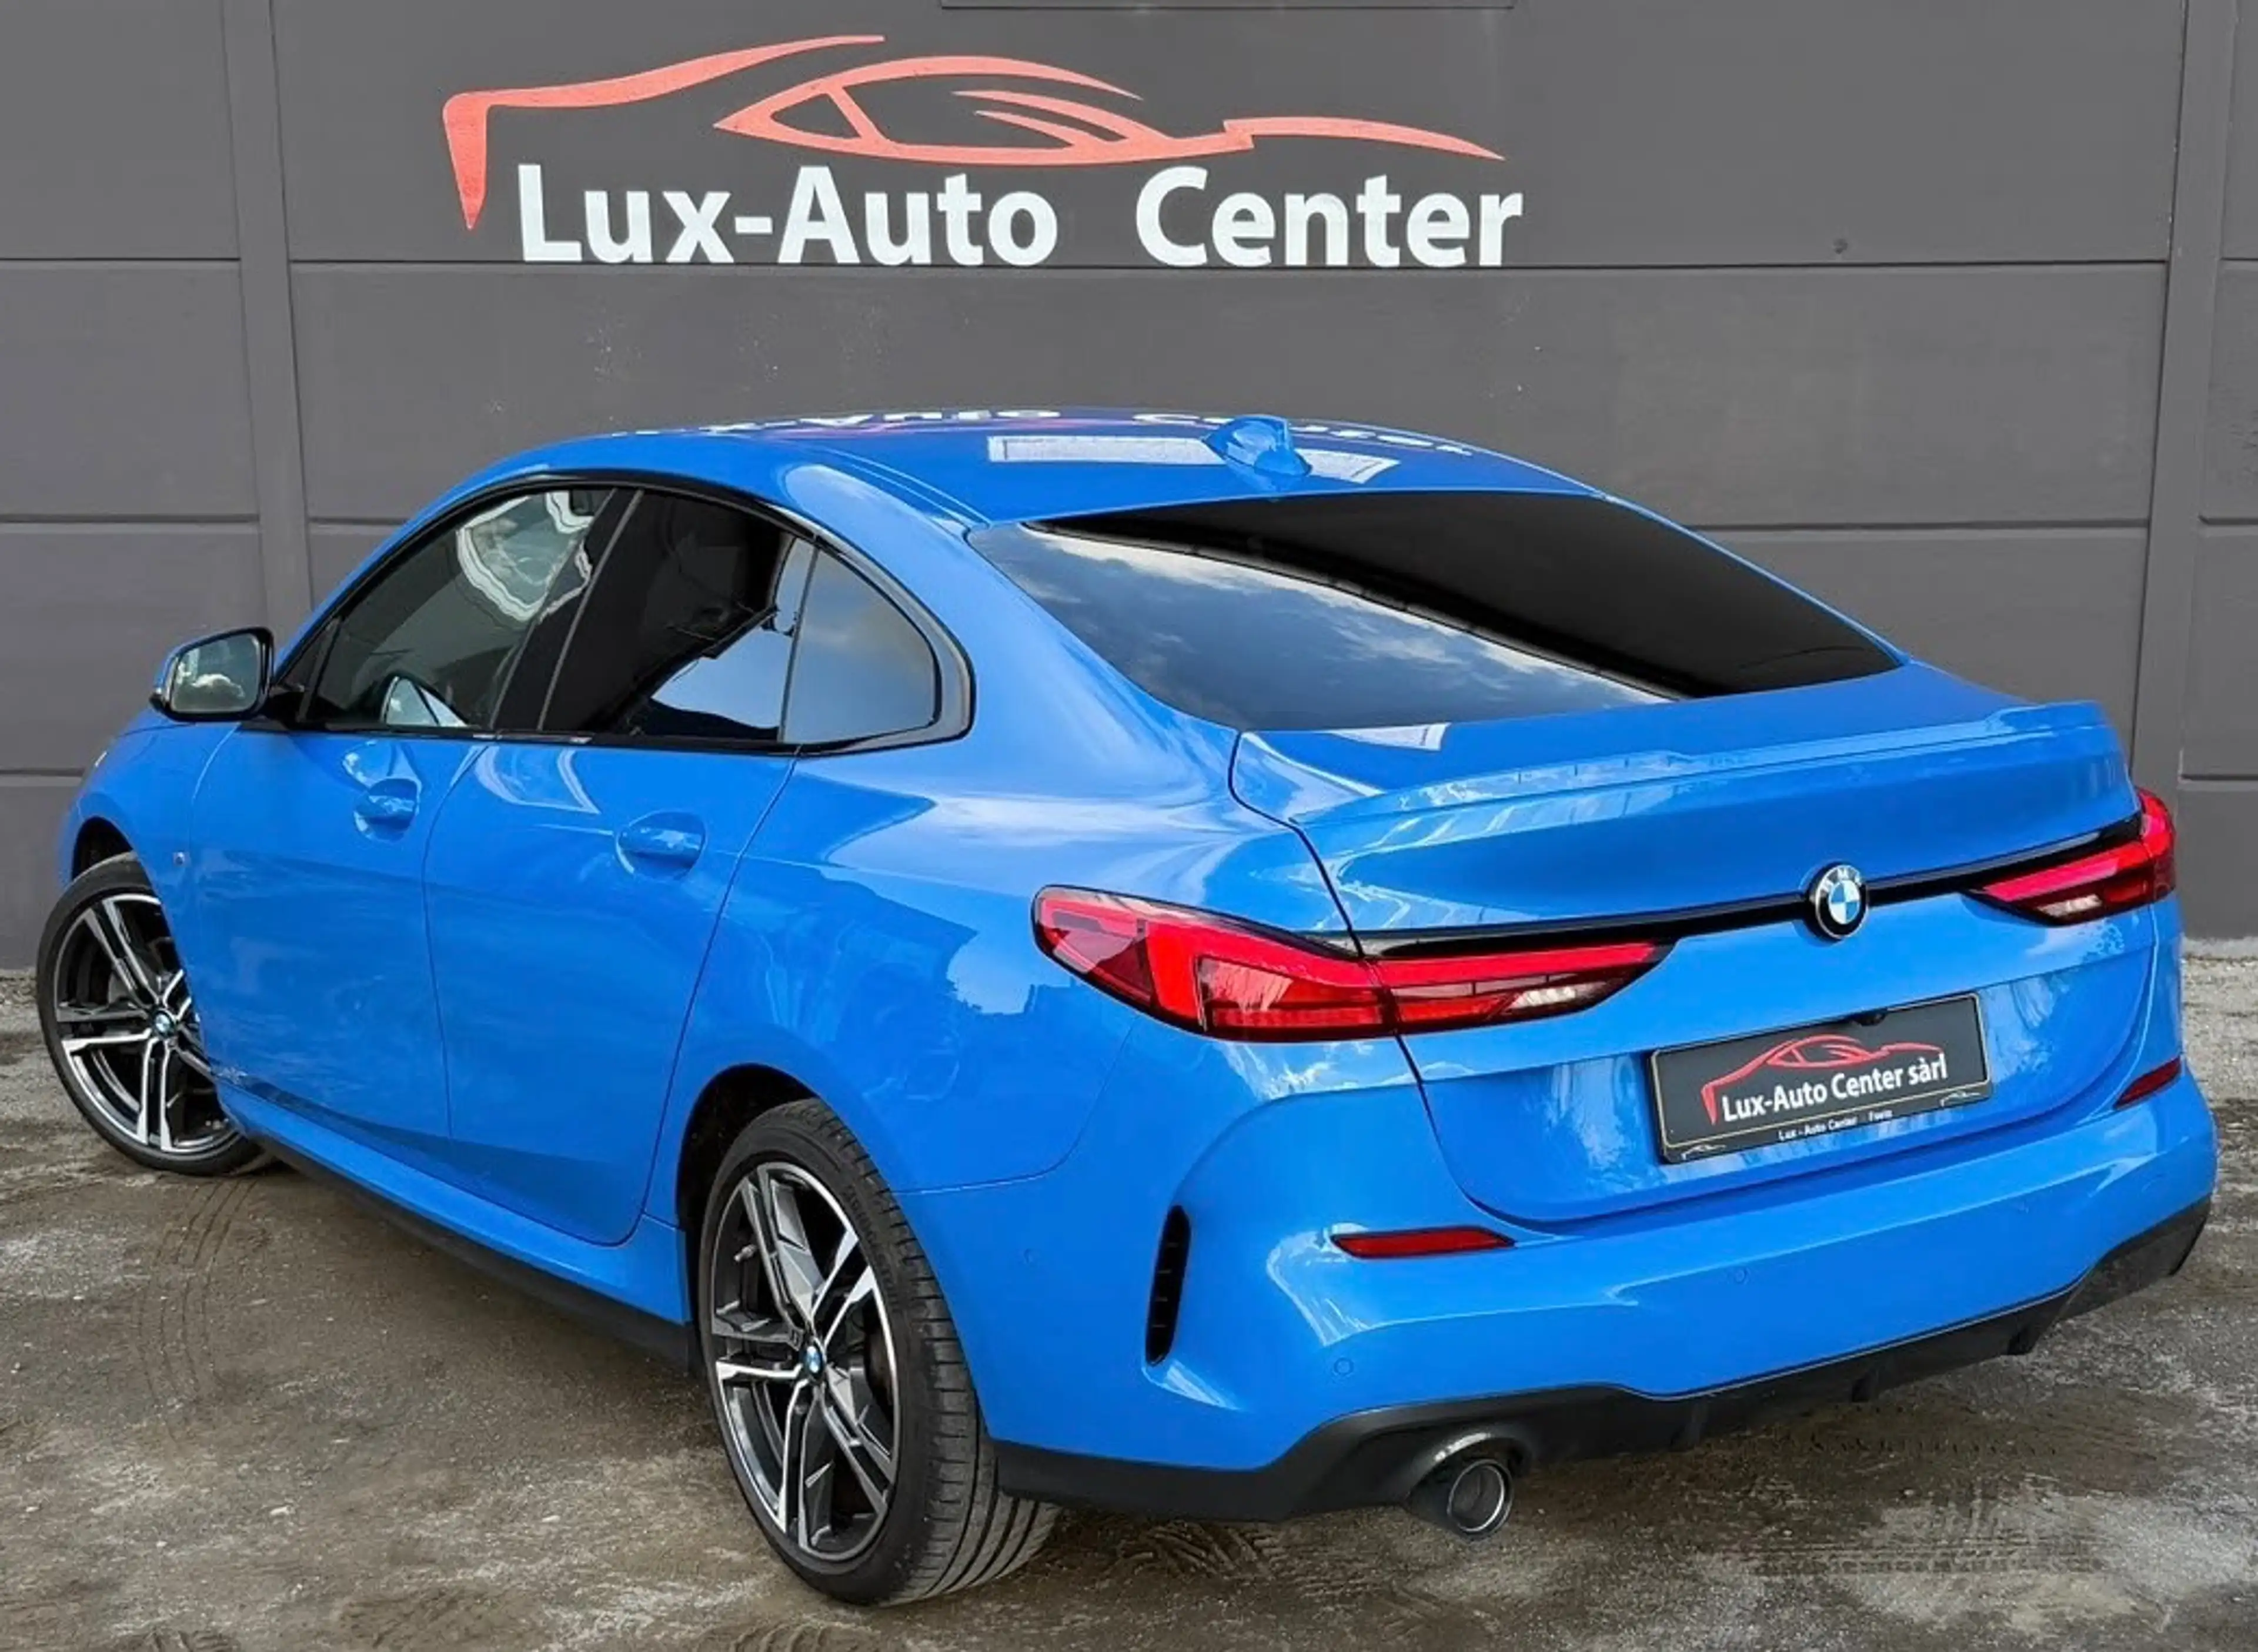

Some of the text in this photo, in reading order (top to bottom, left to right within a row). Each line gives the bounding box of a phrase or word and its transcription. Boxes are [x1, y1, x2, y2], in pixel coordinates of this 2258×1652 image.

[517, 164, 1523, 267] Lux-Auto Center
[1722, 1052, 1948, 1122] Lux-Auto Center sàrl
